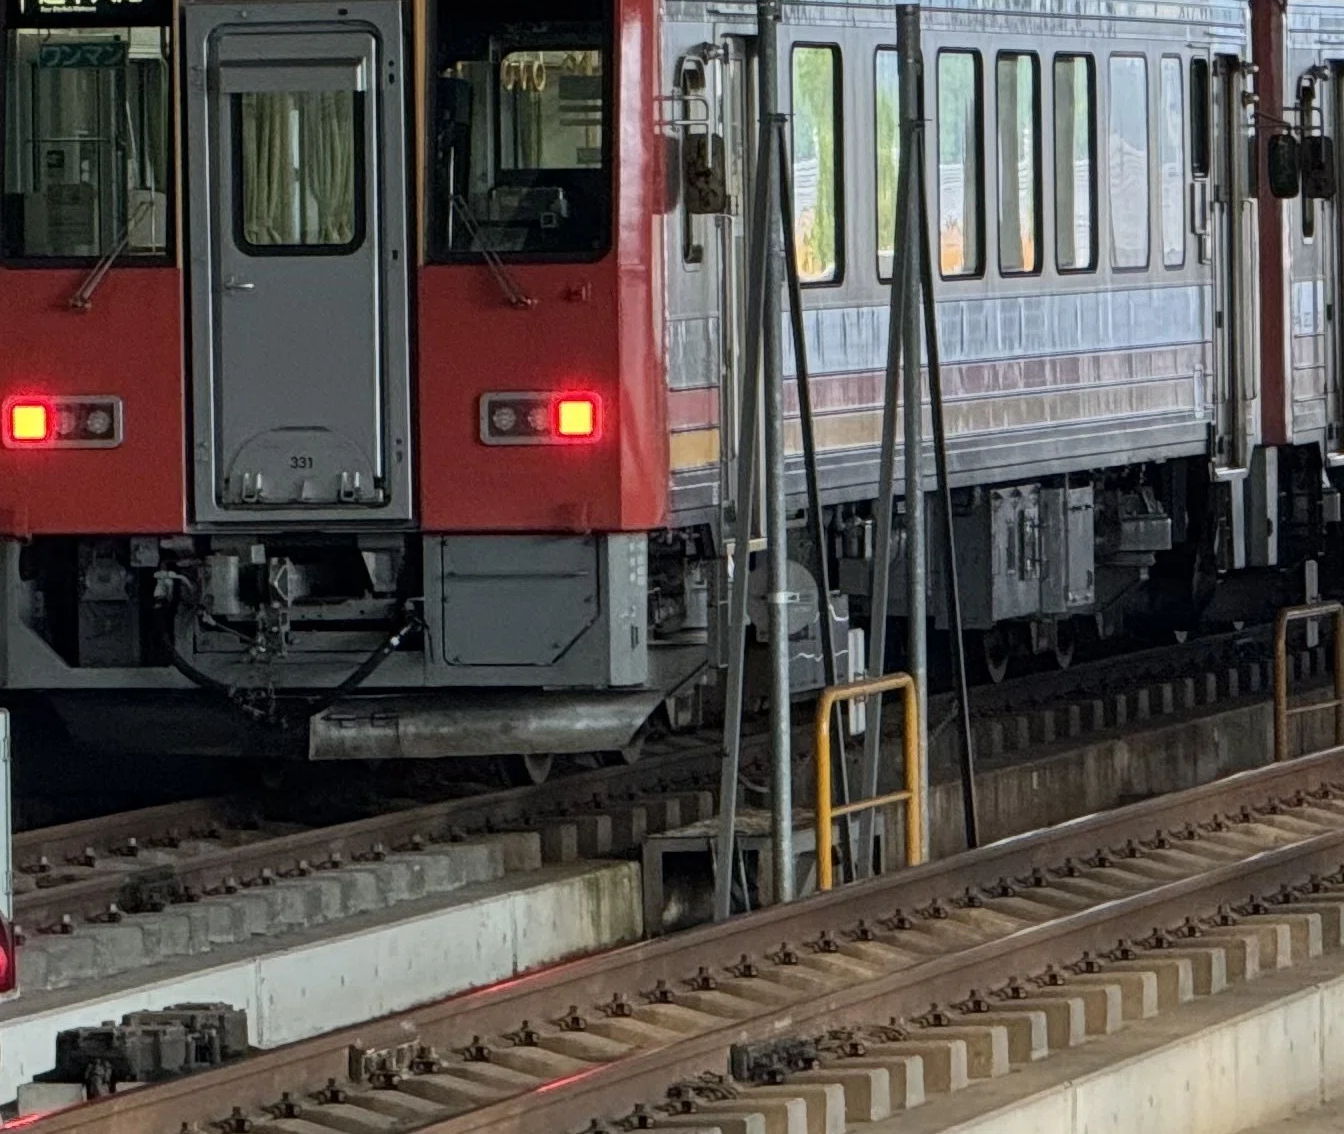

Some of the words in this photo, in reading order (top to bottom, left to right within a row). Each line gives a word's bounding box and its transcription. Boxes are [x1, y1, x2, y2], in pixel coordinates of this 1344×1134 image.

[41, 44, 123, 66] ワンマン
[289, 456, 314, 469] 331
